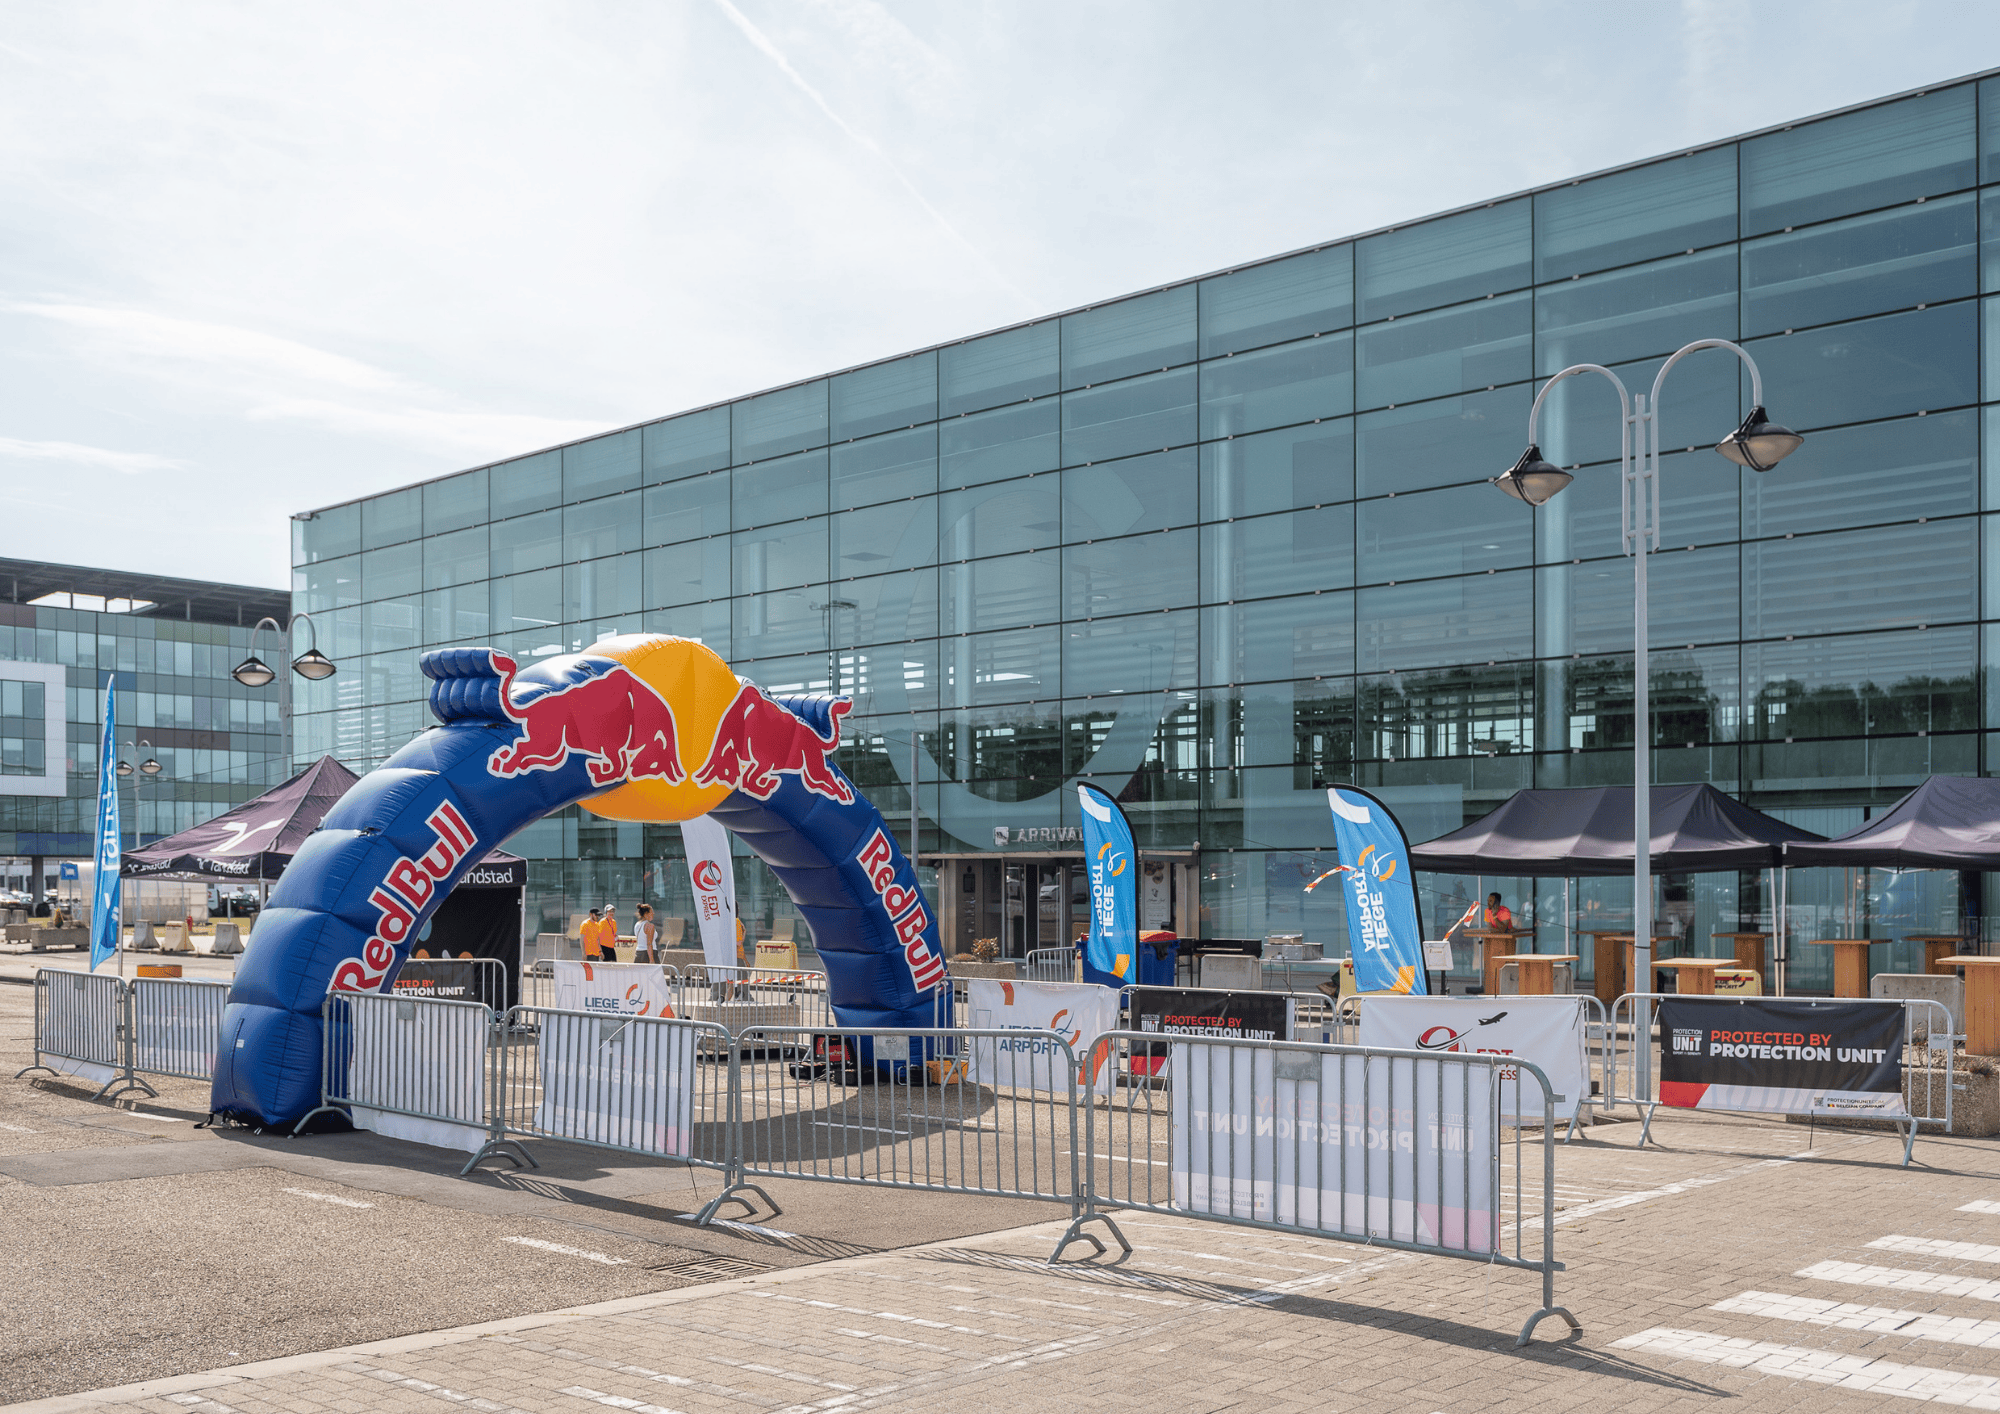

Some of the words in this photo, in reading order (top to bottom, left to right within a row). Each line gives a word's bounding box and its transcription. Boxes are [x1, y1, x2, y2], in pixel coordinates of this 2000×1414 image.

[460, 868, 513, 884] andstad
[708, 896, 720, 918] EDT
[392, 986, 435, 996] ECTION
[438, 986, 466, 996] UNIT
[585, 996, 620, 1009] LIEGE
[1164, 1015, 1225, 1026] PROTECTED
[1228, 1018, 1242, 1028] BY
[1710, 1030, 1804, 1045] PROTECTED
[1810, 1034, 1832, 1046] BY
[1709, 1043, 1831, 1062] PROTECTION
[1836, 1048, 1886, 1064] UNIT
